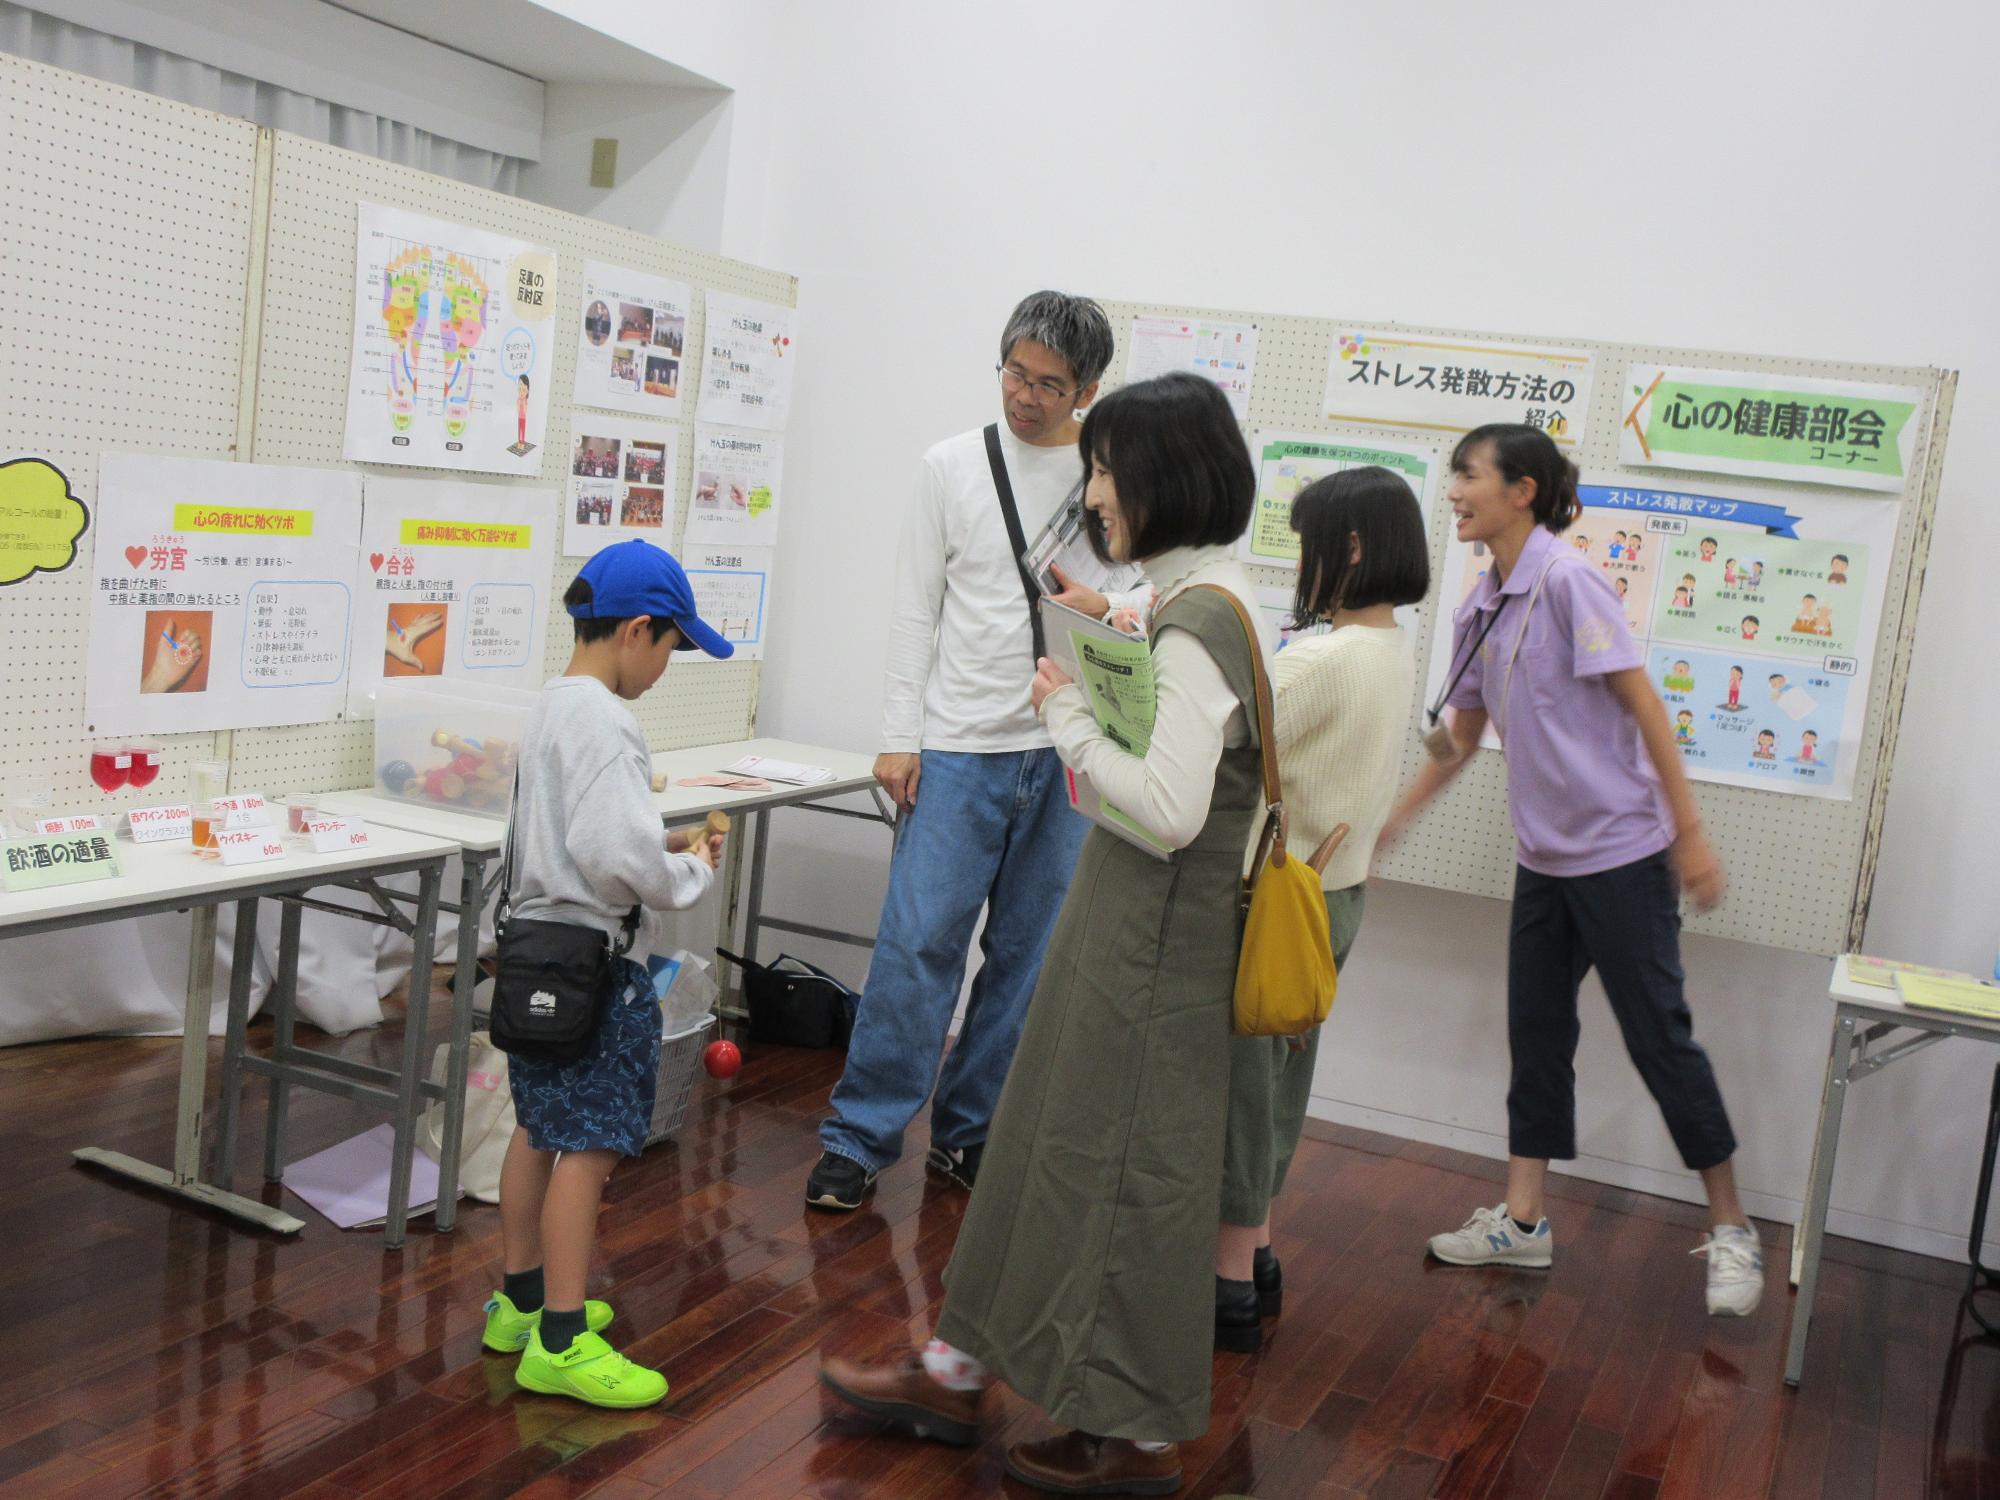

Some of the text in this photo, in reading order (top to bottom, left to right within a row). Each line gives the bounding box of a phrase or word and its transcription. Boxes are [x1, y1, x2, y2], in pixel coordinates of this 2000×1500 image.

[518, 268, 544, 288] 足裏の
[516, 286, 544, 306] 反射区
[1347, 359, 1577, 405] ストレス発散方法の
[1524, 407, 1567, 430] 紹介
[1662, 392, 1887, 450] 心の健康部会
[1284, 446, 1406, 466] 心の健康を保つ4つのポイント
[1809, 445, 1879, 465] コーナー
[1606, 490, 1739, 517] ストレス発散マップ
[193, 510, 295, 530] 心の疲れに効くツボ
[151, 534, 185, 544] ろうきゅう
[149, 545, 189, 572] 労宮
[386, 554, 415, 577] 合谷
[100, 577, 168, 591] 指を曲げた時に
[108, 592, 241, 606] 中指と薬指の間の当たるところ
[242, 798, 264, 809] 180ml
[70, 817, 97, 831] 100ml
[350, 832, 368, 844] 60ml
[6, 836, 113, 873] 飲酒の適量
[263, 843, 284, 856] 60ml
[1486, 1230, 1513, 1253] N
